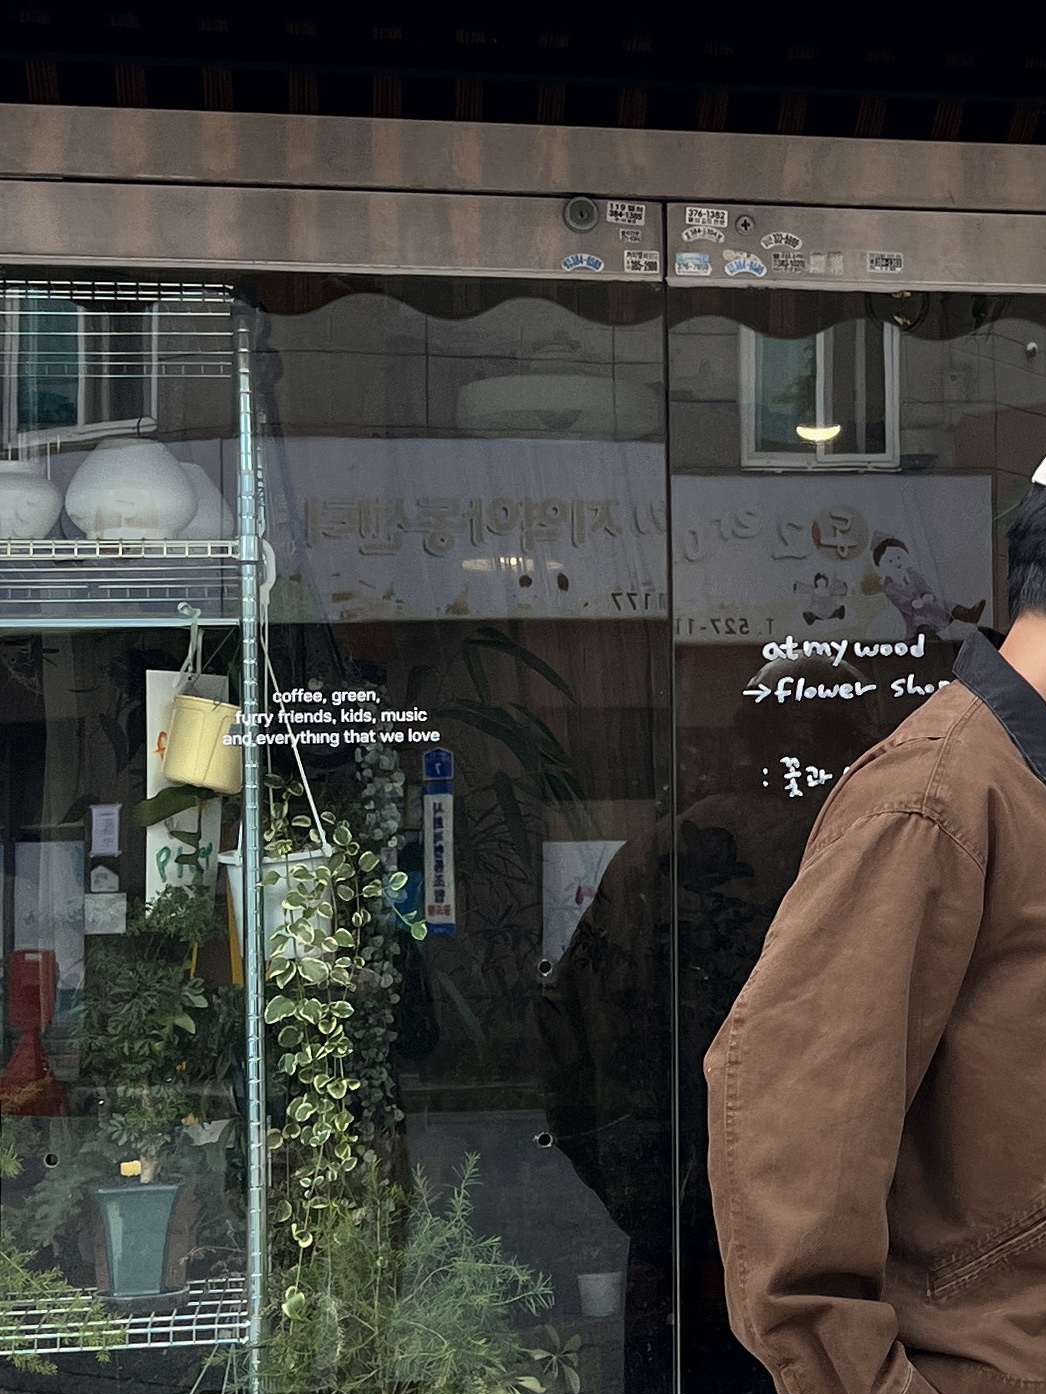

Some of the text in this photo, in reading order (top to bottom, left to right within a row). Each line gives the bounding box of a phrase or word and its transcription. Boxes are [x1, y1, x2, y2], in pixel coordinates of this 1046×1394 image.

[854, 634, 925, 658] wood
[272, 689, 381, 706] coffee, green,
[774, 677, 877, 703] flower
[235, 707, 428, 727] furry friends, kids, music
[222, 728, 441, 748] and everything that we love
